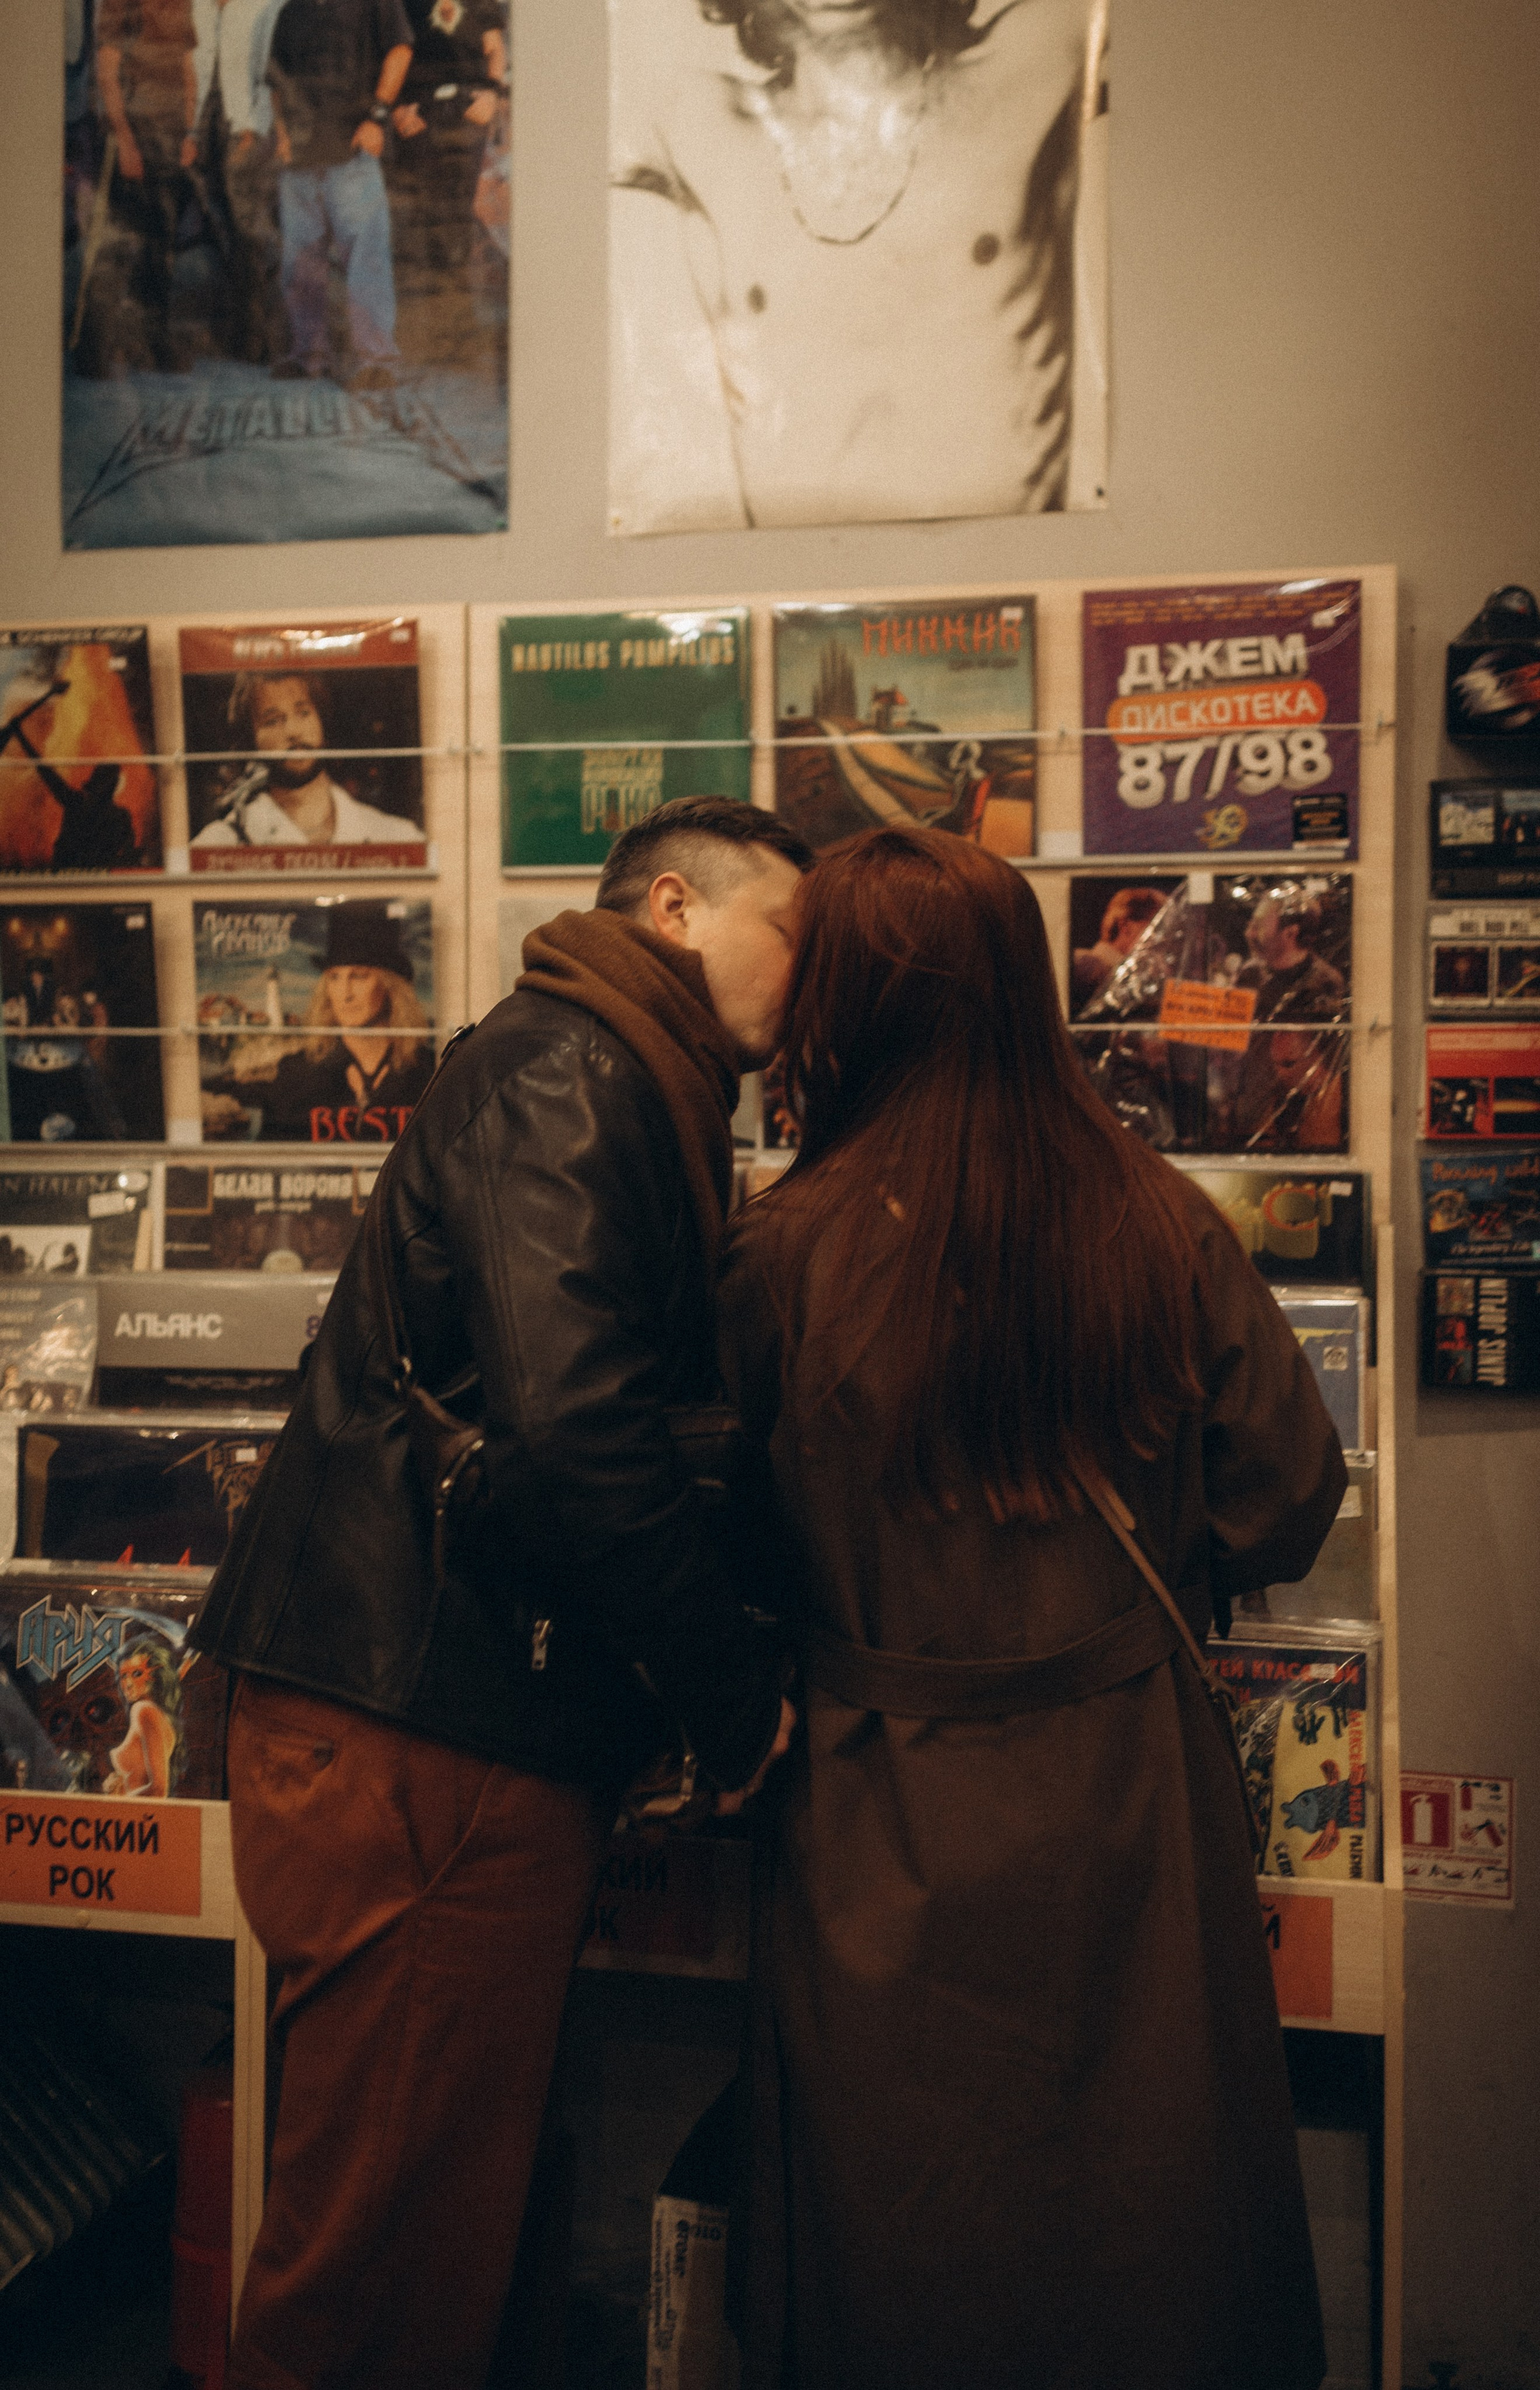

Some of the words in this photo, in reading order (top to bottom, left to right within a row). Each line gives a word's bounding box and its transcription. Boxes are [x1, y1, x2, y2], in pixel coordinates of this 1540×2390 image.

[512, 640, 609, 673] NAUTILUS
[620, 636, 735, 669] POMPILIUS
[862, 614, 1022, 658] ПИКНИК
[1118, 632, 1309, 697] ДЖЕМ
[1121, 689, 1320, 735] ДИСКОТЕКА
[1117, 730, 1333, 808] 87/98
[309, 1106, 417, 1144] BEST
[114, 1313, 223, 1339] АЛЬЯНС
[1477, 1278, 1508, 1335] JOPLIN
[1477, 1338, 1507, 1386] JANIS
[16, 1594, 134, 1693] АРИЯ
[5, 1813, 159, 1855] РУССКИЙ
[49, 1864, 116, 1902] РОК
